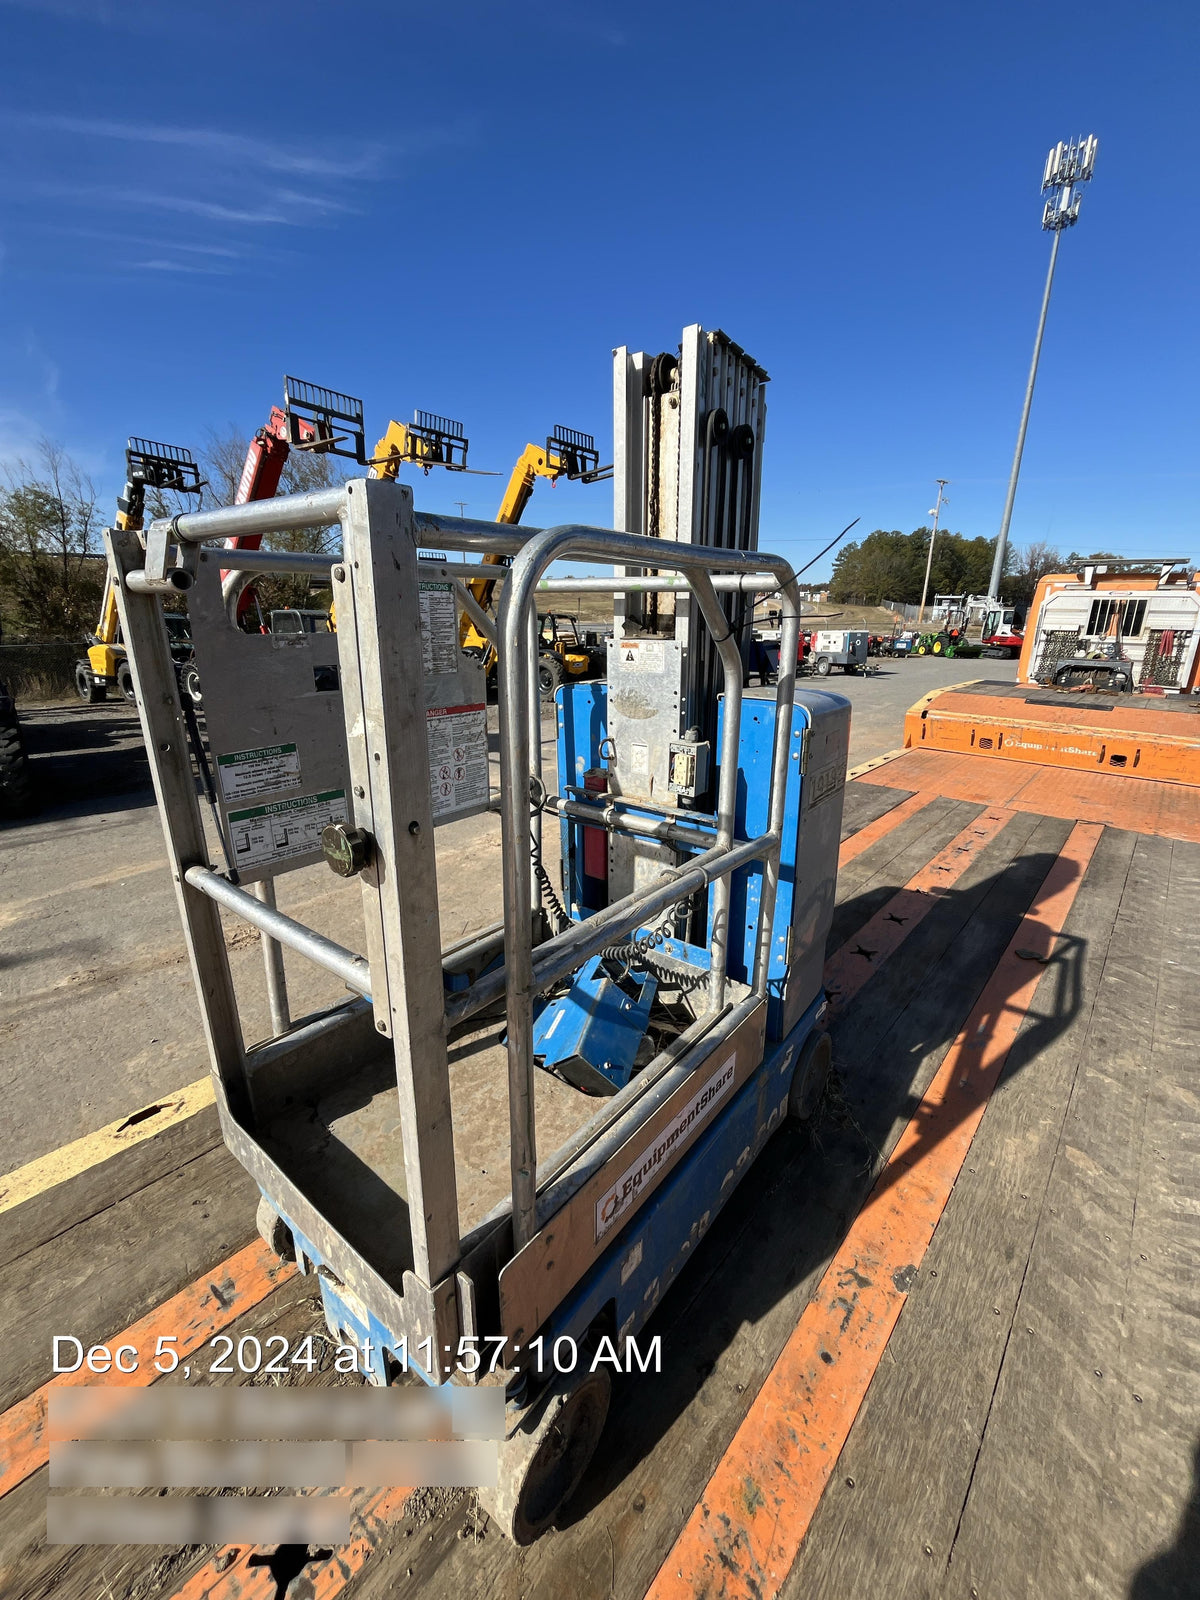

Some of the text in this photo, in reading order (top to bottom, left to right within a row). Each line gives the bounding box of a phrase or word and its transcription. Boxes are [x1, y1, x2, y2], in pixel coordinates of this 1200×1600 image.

[234, 448, 257, 504] ANITOU
[419, 583, 449, 591] TRUCTIONS
[426, 708, 448, 717] ANGER
[234, 747, 282, 760] INSTRUCTIONS
[265, 796, 318, 813] INSTRUCTIONS
[621, 1065, 734, 1199] EquipmentShare
